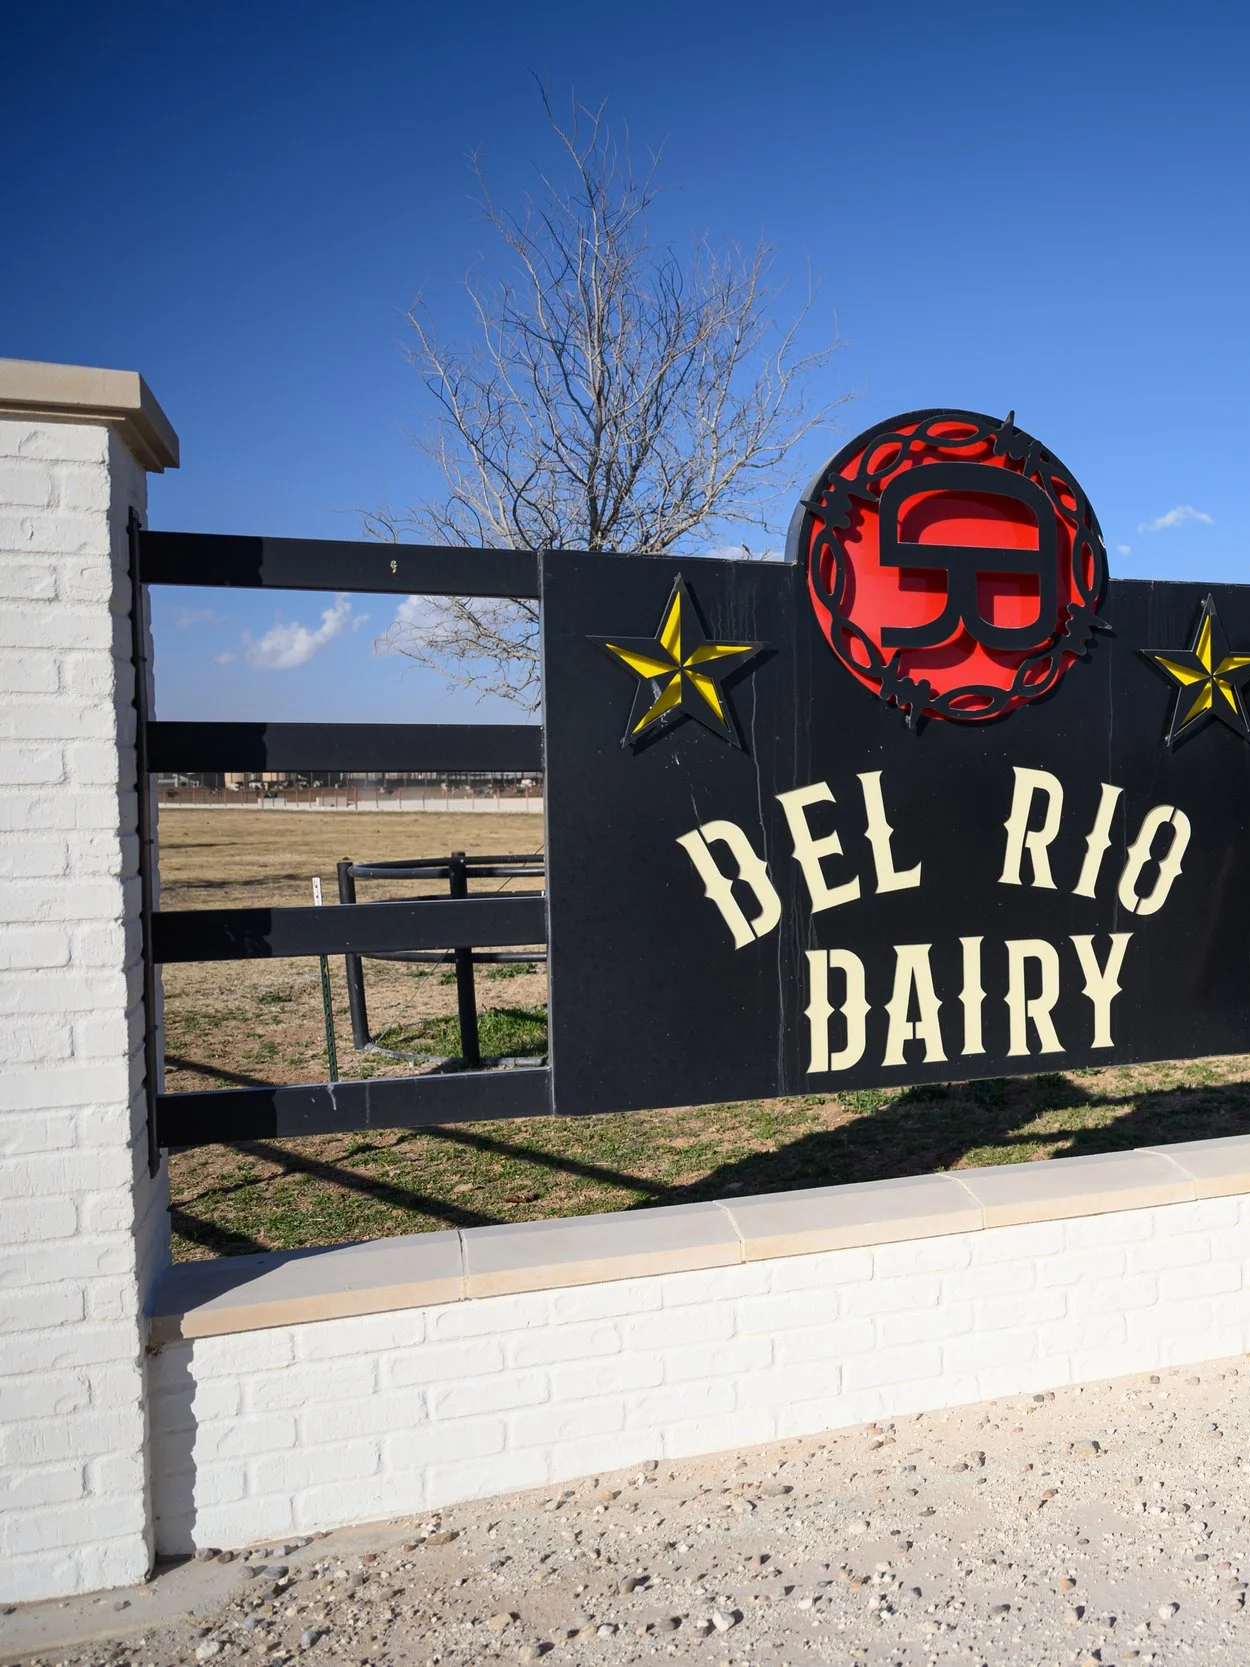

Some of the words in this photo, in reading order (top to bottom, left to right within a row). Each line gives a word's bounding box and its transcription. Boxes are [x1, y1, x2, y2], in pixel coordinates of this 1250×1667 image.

[676, 770, 922, 950] DEL
[998, 766, 1191, 916] RIO
[803, 932, 1134, 1074] DAIRY
